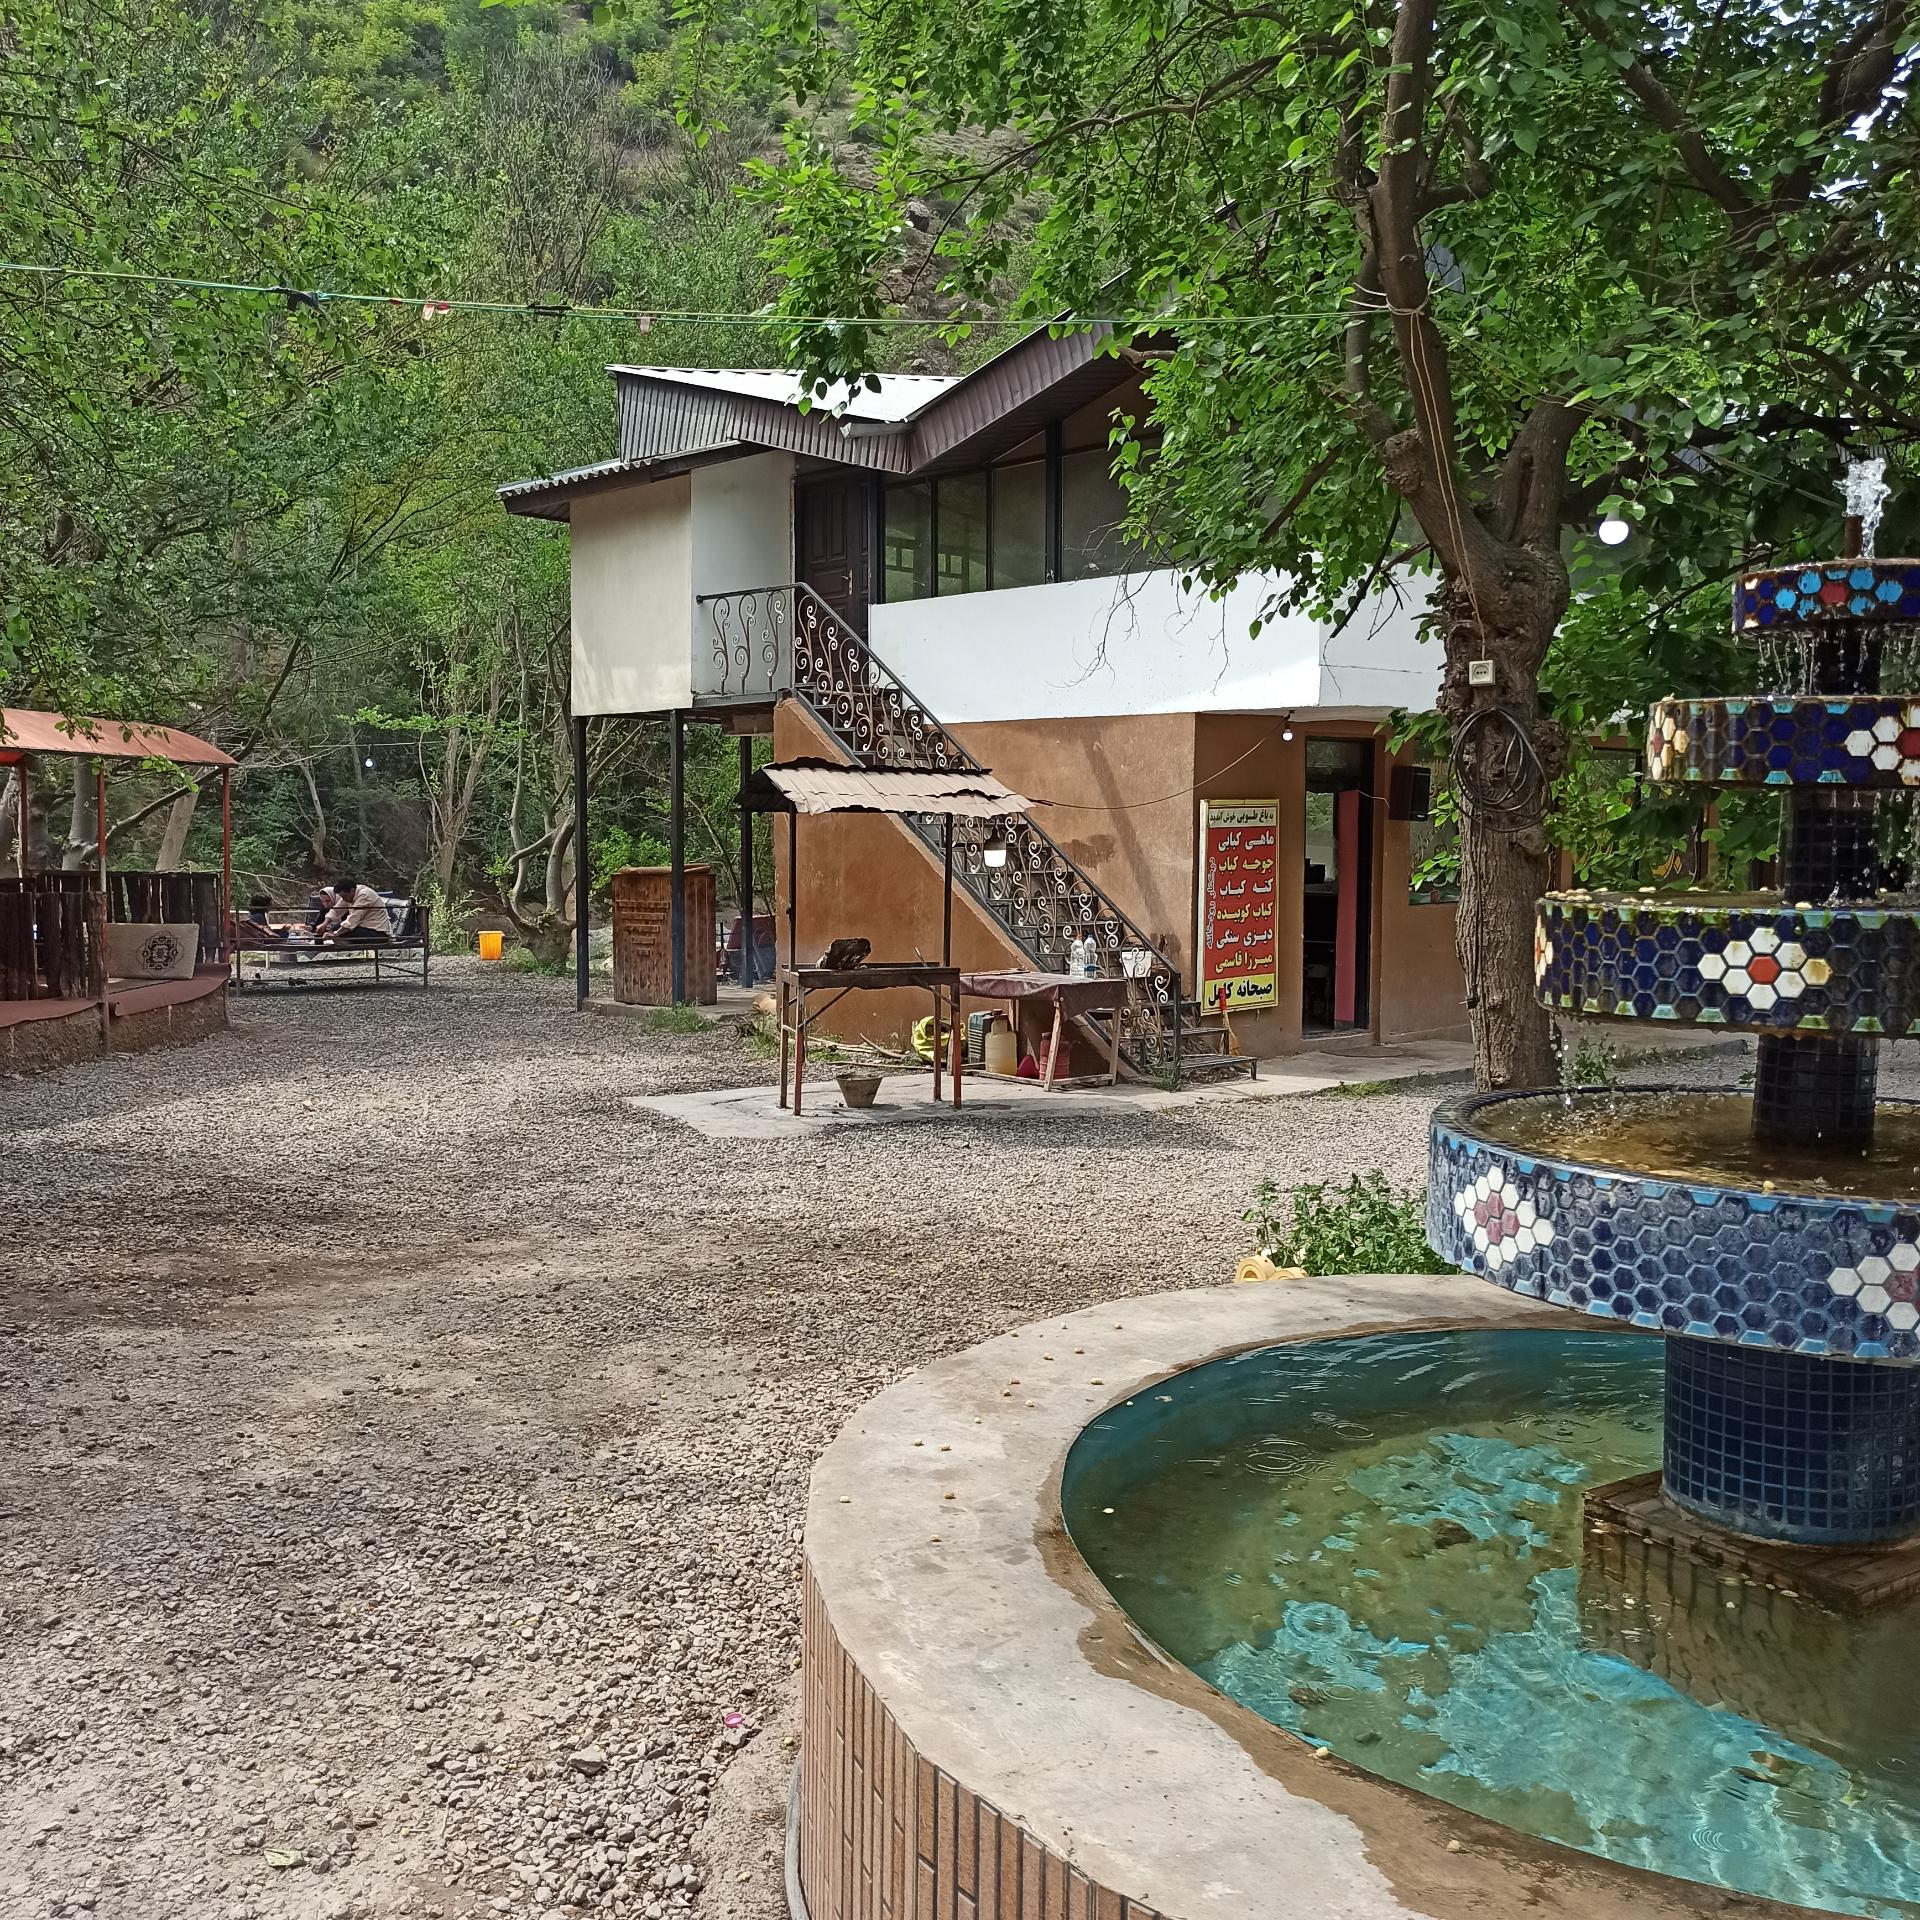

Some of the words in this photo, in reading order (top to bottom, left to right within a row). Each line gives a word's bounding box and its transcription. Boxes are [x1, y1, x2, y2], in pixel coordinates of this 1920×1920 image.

[1223, 812, 1236, 823] خوش
[1259, 809, 1269, 823] باغ
[1218, 831, 1242, 852] کبابی
[1245, 830, 1275, 851] ماهی
[1218, 856, 1239, 875] کباب
[1242, 859, 1274, 874] جوجه
[1219, 879, 1247, 899] کباب
[1252, 877, 1274, 893] کته
[1216, 903, 1251, 922] کوبیده
[1252, 901, 1274, 921] کباب
[1206, 901, 1216, 949] رودخانه
[1216, 928, 1240, 949] سنگی
[1243, 928, 1273, 947] دیزی
[1215, 950, 1243, 973] قاسمی
[1244, 951, 1273, 970] میرزا
[1236, 980, 1273, 1000] صبحانه
